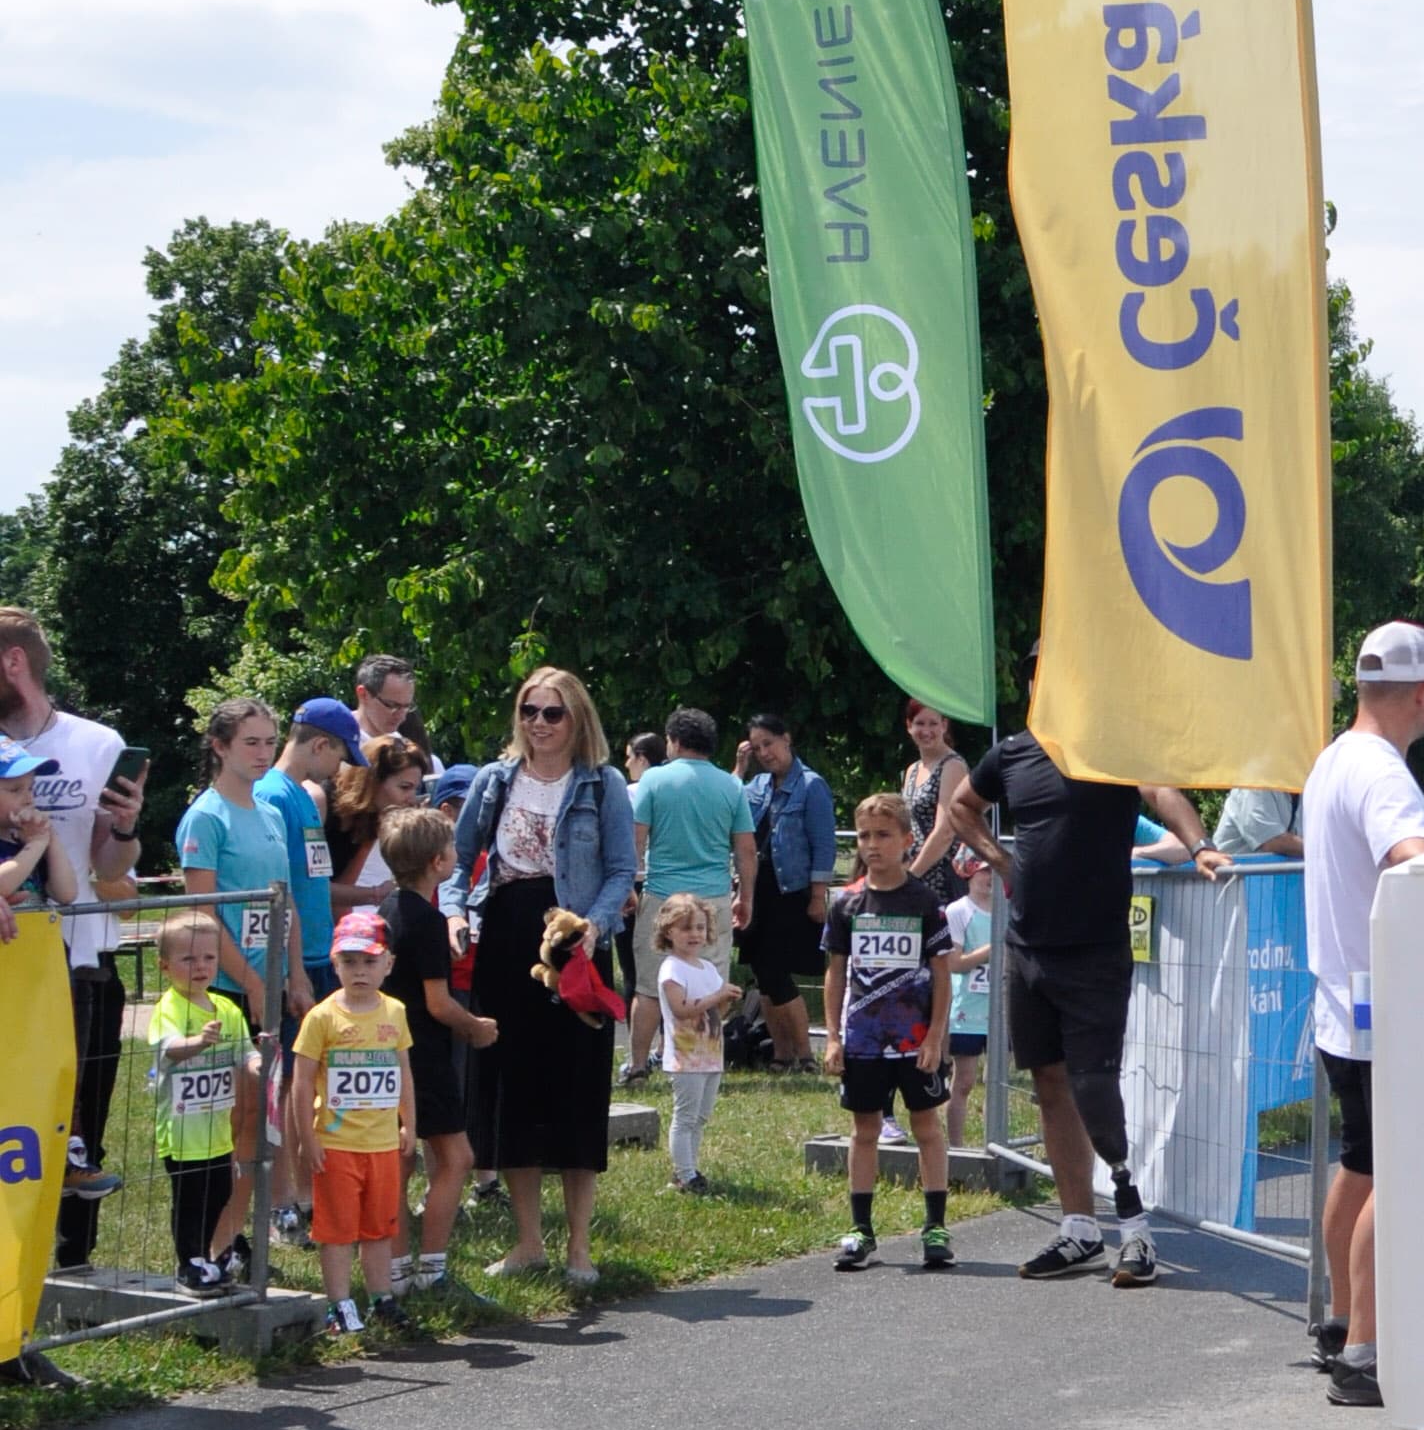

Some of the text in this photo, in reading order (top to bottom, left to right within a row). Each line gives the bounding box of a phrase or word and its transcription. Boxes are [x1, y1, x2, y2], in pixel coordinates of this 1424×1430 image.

[858, 934, 912, 956] 2140
[180, 1070, 233, 1101] 2079
[336, 1070, 397, 1096] 2076
